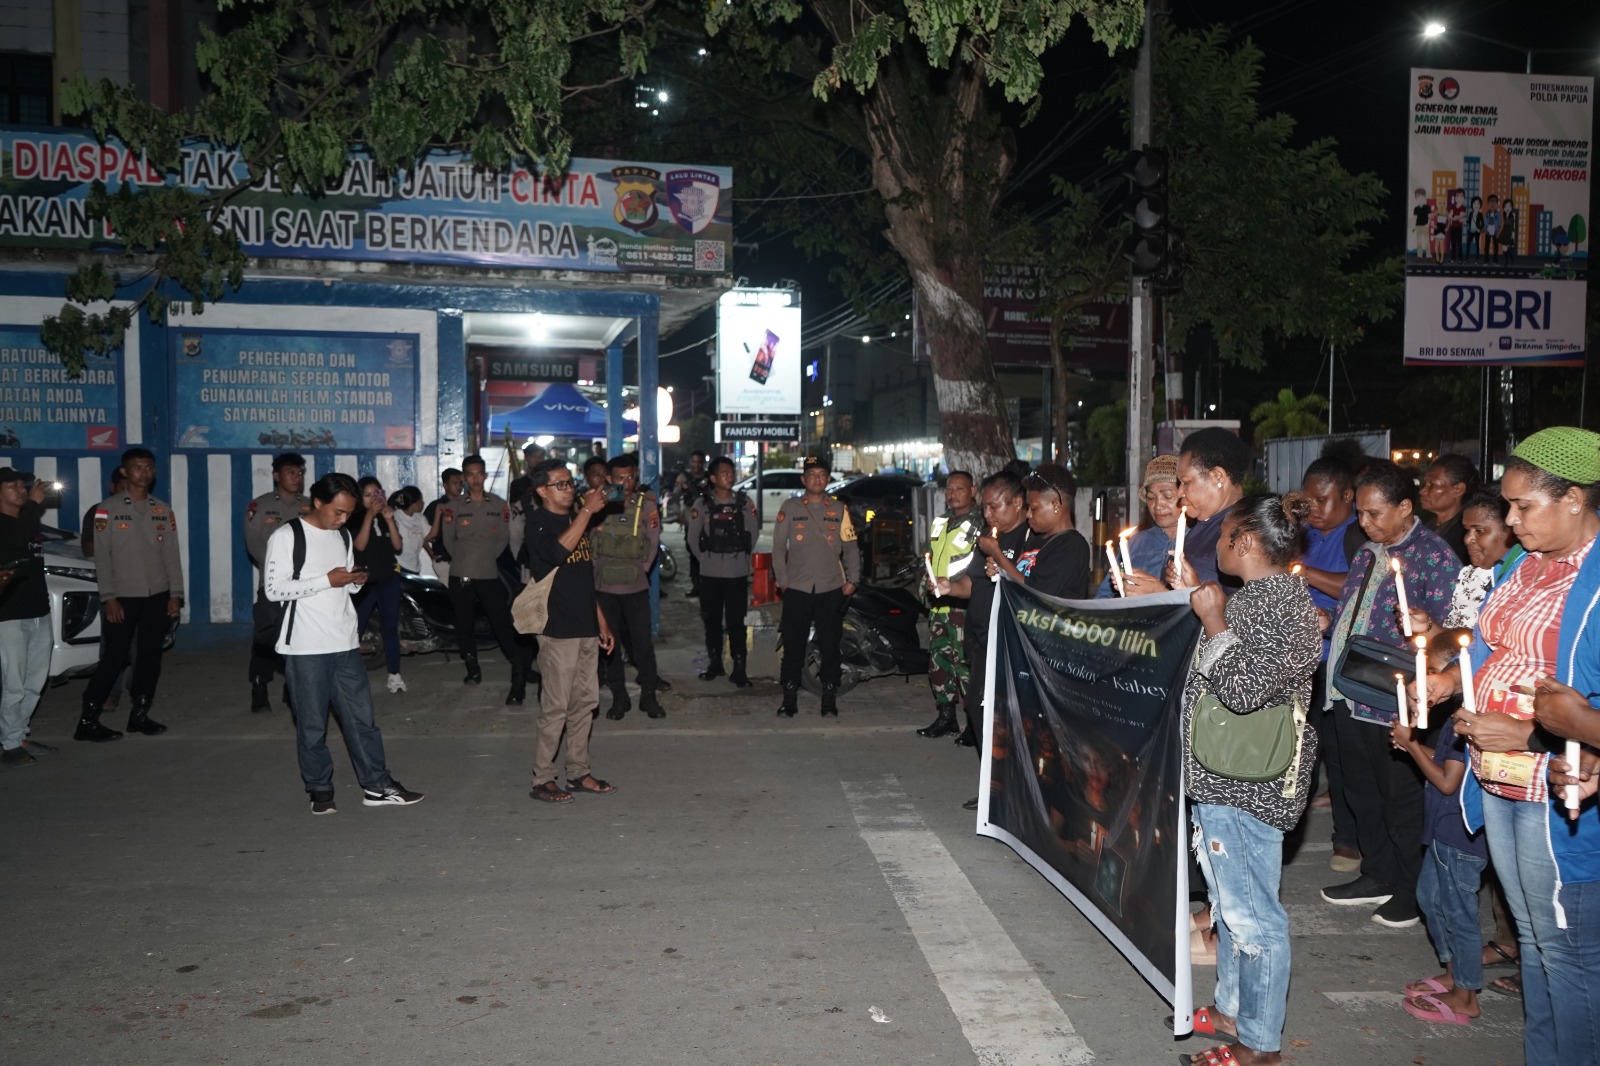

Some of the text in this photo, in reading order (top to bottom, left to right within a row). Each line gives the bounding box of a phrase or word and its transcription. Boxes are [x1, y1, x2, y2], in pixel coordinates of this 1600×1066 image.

[1530, 83, 1588, 93] DITRESNARKOBA
[1530, 92, 1588, 104] POLDA PAPUA
[1415, 103, 1498, 115] GENERASI MILENIAL
[1415, 115, 1498, 127] MARI HIDUP SEHAT
[1415, 126, 1486, 137] JAUHI NARKOBA
[1491, 137, 1589, 149] JADILAH SOSOK INSPIRASI
[1507, 147, 1588, 158] DAN PELOPOR DALAM
[1542, 159, 1587, 168] MEMERANGI
[178, 149, 239, 189] TAK
[398, 162, 501, 202] JATUH
[510, 167, 602, 207] CINTA
[615, 168, 657, 178] PAPUA
[670, 172, 716, 183] LALU LINTAS
[1533, 168, 1587, 182] NARKOBA
[206, 206, 263, 244] SNI
[273, 208, 358, 248] SAAT
[366, 213, 578, 258] BERKENDARA
[619, 243, 642, 251] Honda
[1486, 289, 1551, 330] BRI
[1419, 347, 1485, 357] BRI BO SENTANI
[1545, 342, 1580, 352] Simpedes
[239, 351, 356, 368] PENGENDARA DAN
[492, 361, 574, 378] SAMSUNG
[203, 369, 390, 387] PENUMPANG SEPEDA MOTOR
[46, 388, 84, 403] ANDA
[201, 388, 393, 406] GUNAKANLAH HELM STANDAR
[543, 402, 589, 413] vivo
[48, 407, 106, 423] LAINNYA
[224, 407, 375, 424] SAYANGILAH DIRI ANDA
[725, 427, 795, 437] FANTASY MOBILE
[1016, 608, 1058, 632] aksi
[1059, 618, 1116, 647] 1000
[1118, 628, 1157, 657] lilin
[1066, 661, 1099, 685] Sokoy
[1113, 676, 1168, 700] Kabey
